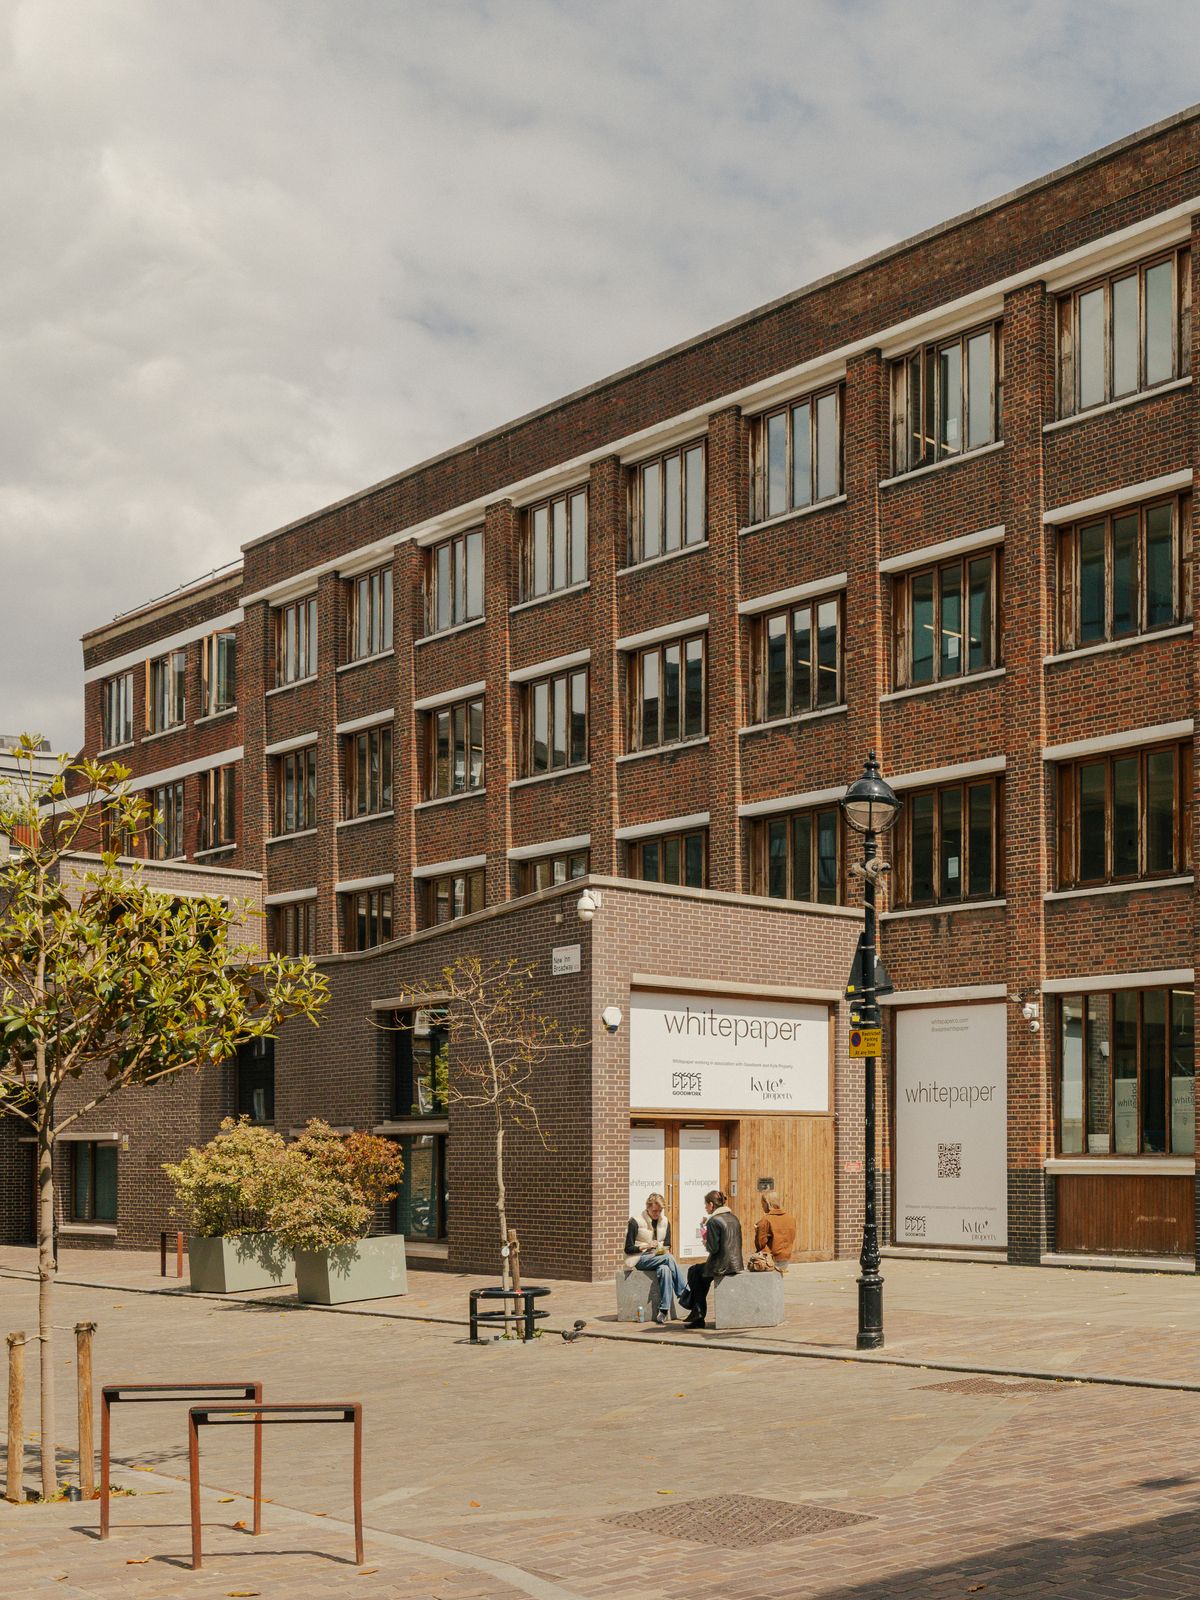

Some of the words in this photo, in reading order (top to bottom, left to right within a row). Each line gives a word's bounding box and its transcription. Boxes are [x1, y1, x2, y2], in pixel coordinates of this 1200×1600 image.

[663, 1006, 802, 1048] whitepaper
[750, 1076, 779, 1092] kyte
[905, 1080, 997, 1109] whitepaper
[684, 1178, 718, 1189] whitepaper
